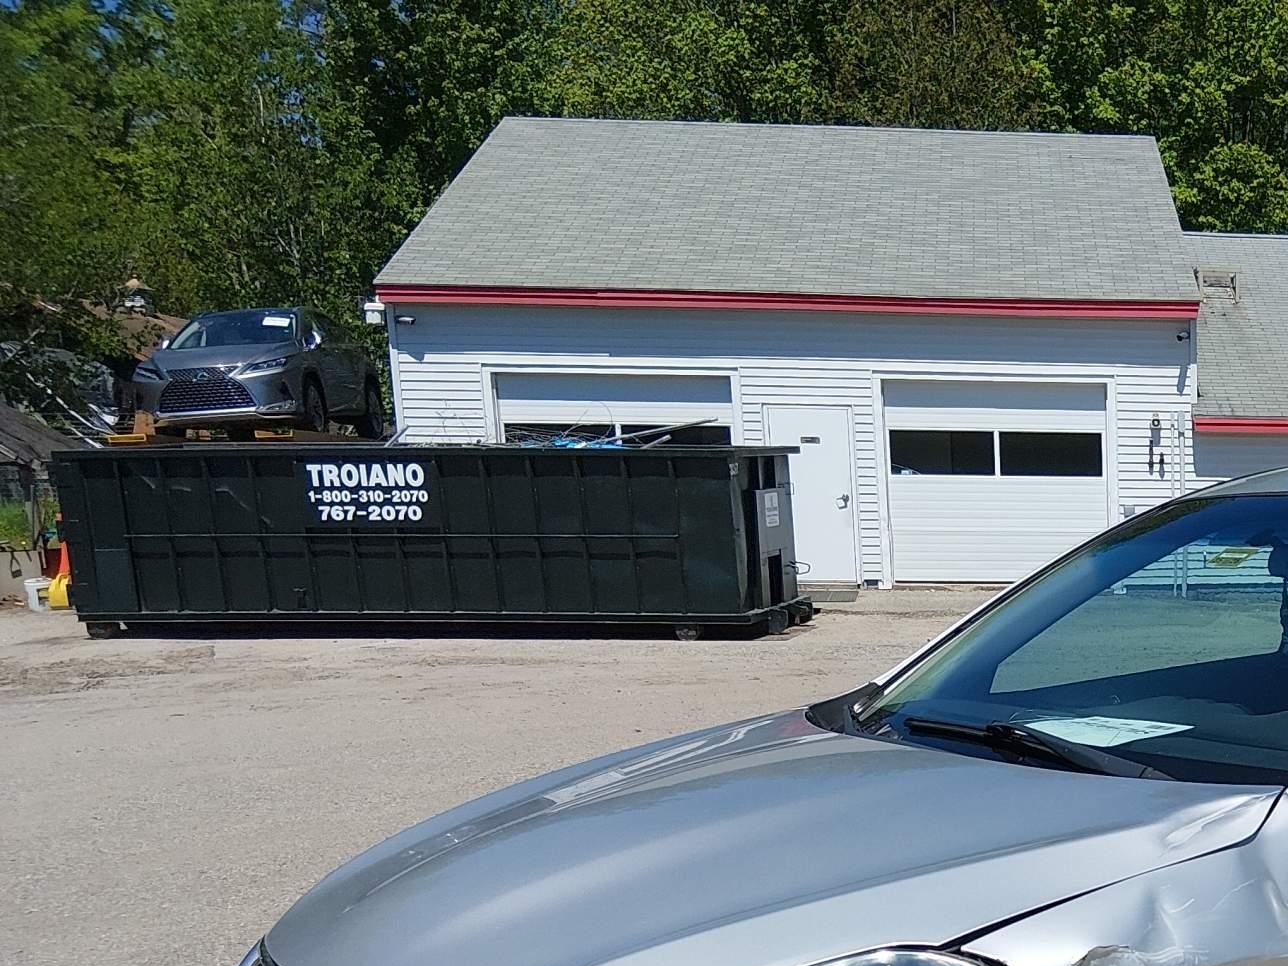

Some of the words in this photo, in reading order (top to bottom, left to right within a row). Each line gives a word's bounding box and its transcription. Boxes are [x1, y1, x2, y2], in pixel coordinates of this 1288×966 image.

[306, 463, 425, 487] TROIANO
[308, 490, 429, 503] 1-800-310-2070
[318, 505, 423, 521] 767-2070
